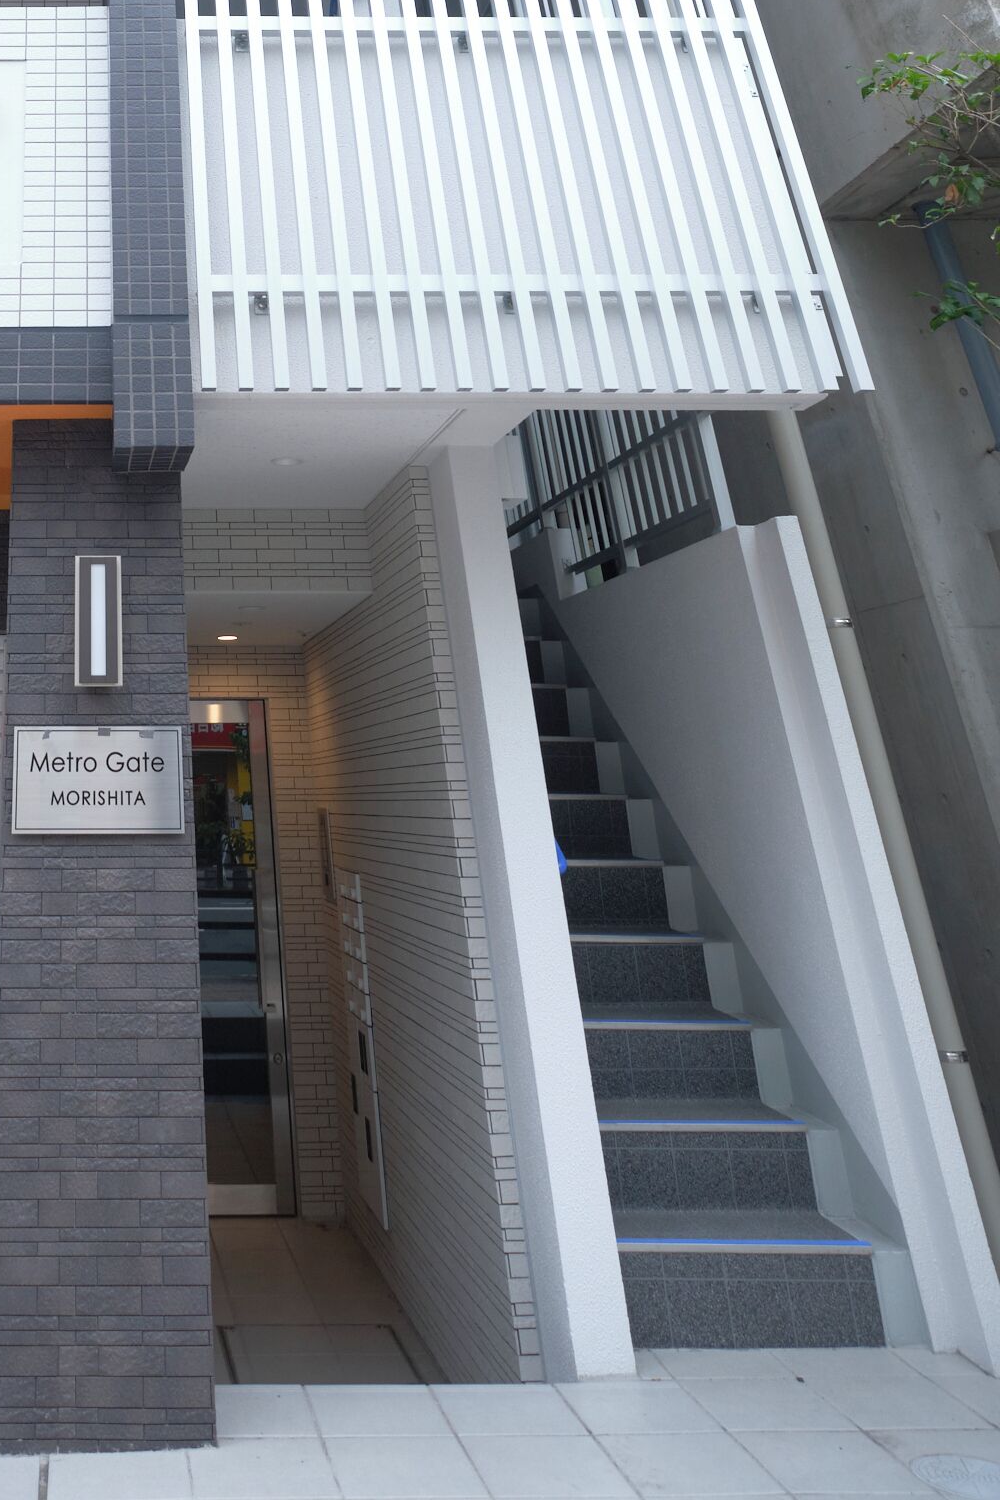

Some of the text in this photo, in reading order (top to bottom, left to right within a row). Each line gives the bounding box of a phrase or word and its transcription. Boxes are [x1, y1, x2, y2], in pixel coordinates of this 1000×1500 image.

[30, 751, 165, 773] Metro Gate
[50, 790, 146, 806] MORISHITA
